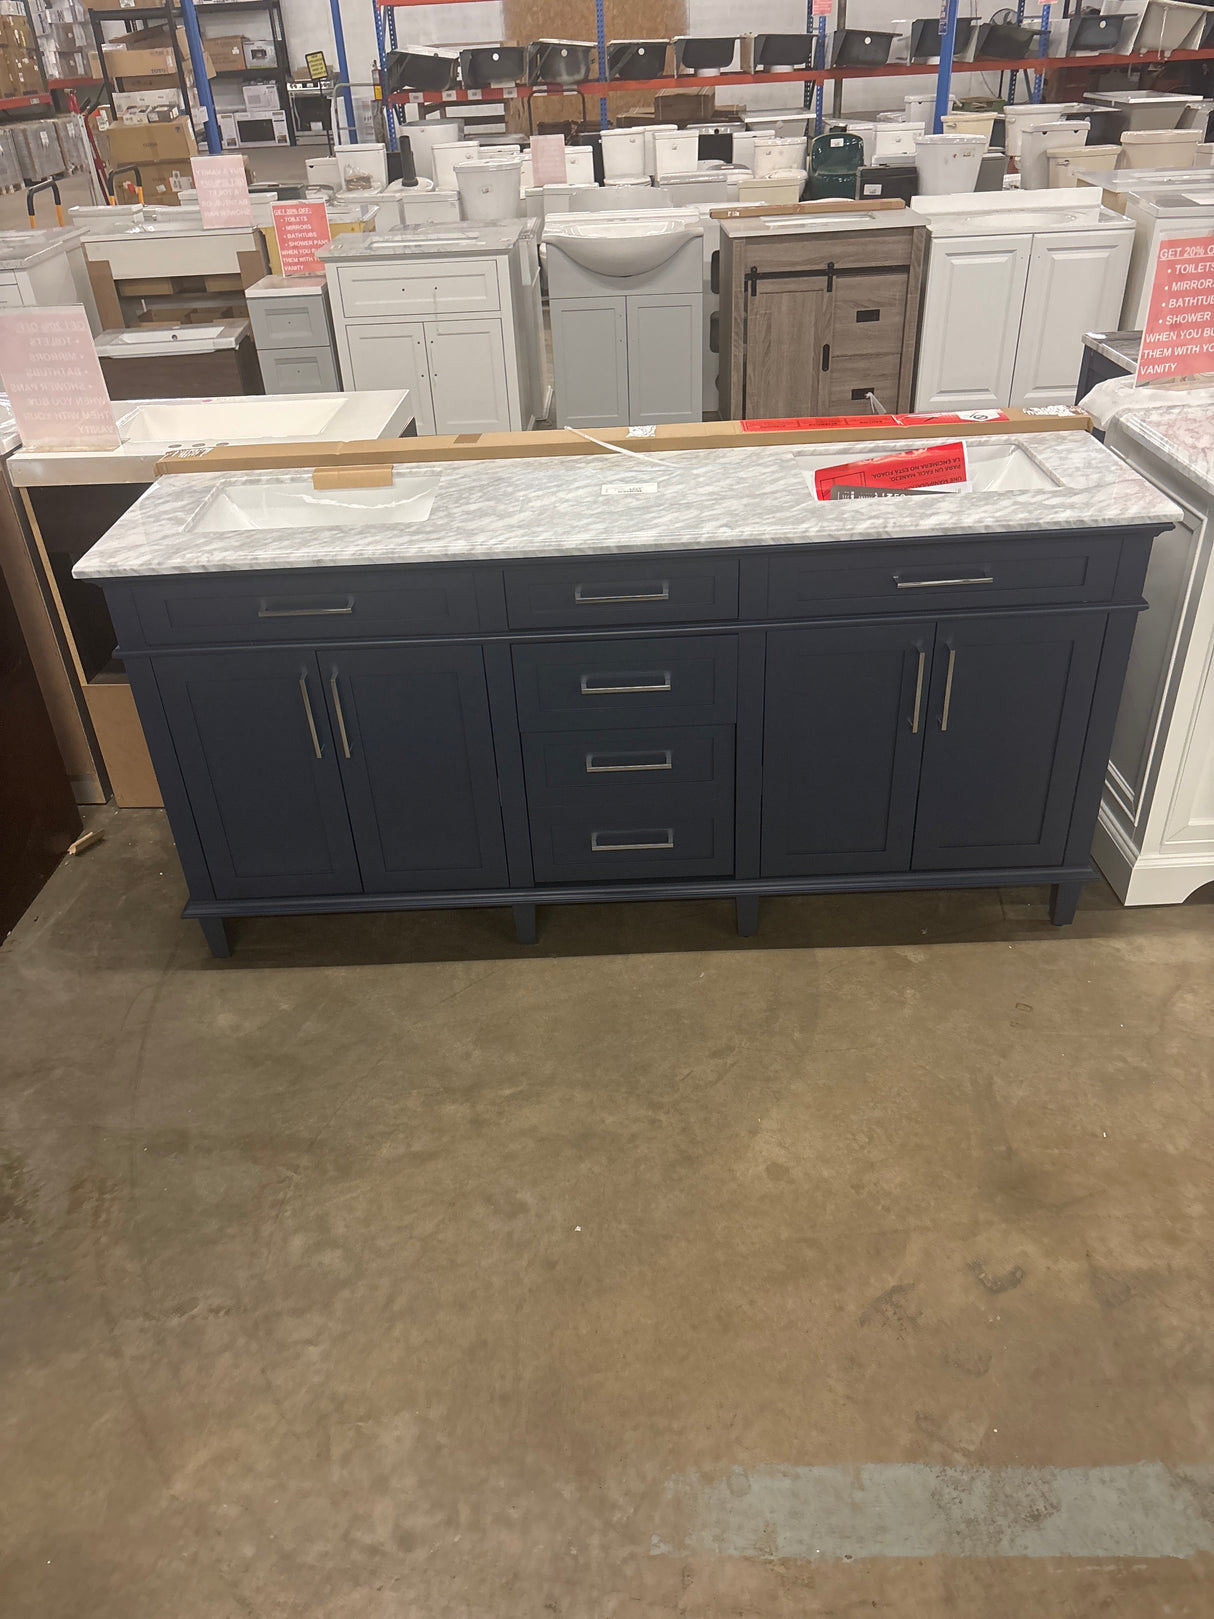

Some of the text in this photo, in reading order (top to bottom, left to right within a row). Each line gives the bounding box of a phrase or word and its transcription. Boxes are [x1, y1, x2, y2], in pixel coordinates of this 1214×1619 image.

[287, 231, 317, 239] BATHTUBS
[281, 248, 298, 256] WHEN
[1159, 248, 1182, 260] GET
[1184, 246, 1205, 257] 20%
[284, 264, 304, 272] VANITY
[1175, 262, 1214, 274] TOILETS
[1171, 279, 1214, 291] MIRROR
[1165, 312, 1211, 325] SHOWER
[1146, 331, 1178, 343] WHEN
[1180, 328, 1202, 340] YOU
[1143, 347, 1172, 359] THEM
[1174, 345, 1200, 356] WITH
[1140, 363, 1178, 375] VANITY
[920, 459, 951, 469] ENCIMERA
[944, 464, 961, 472] PARA
